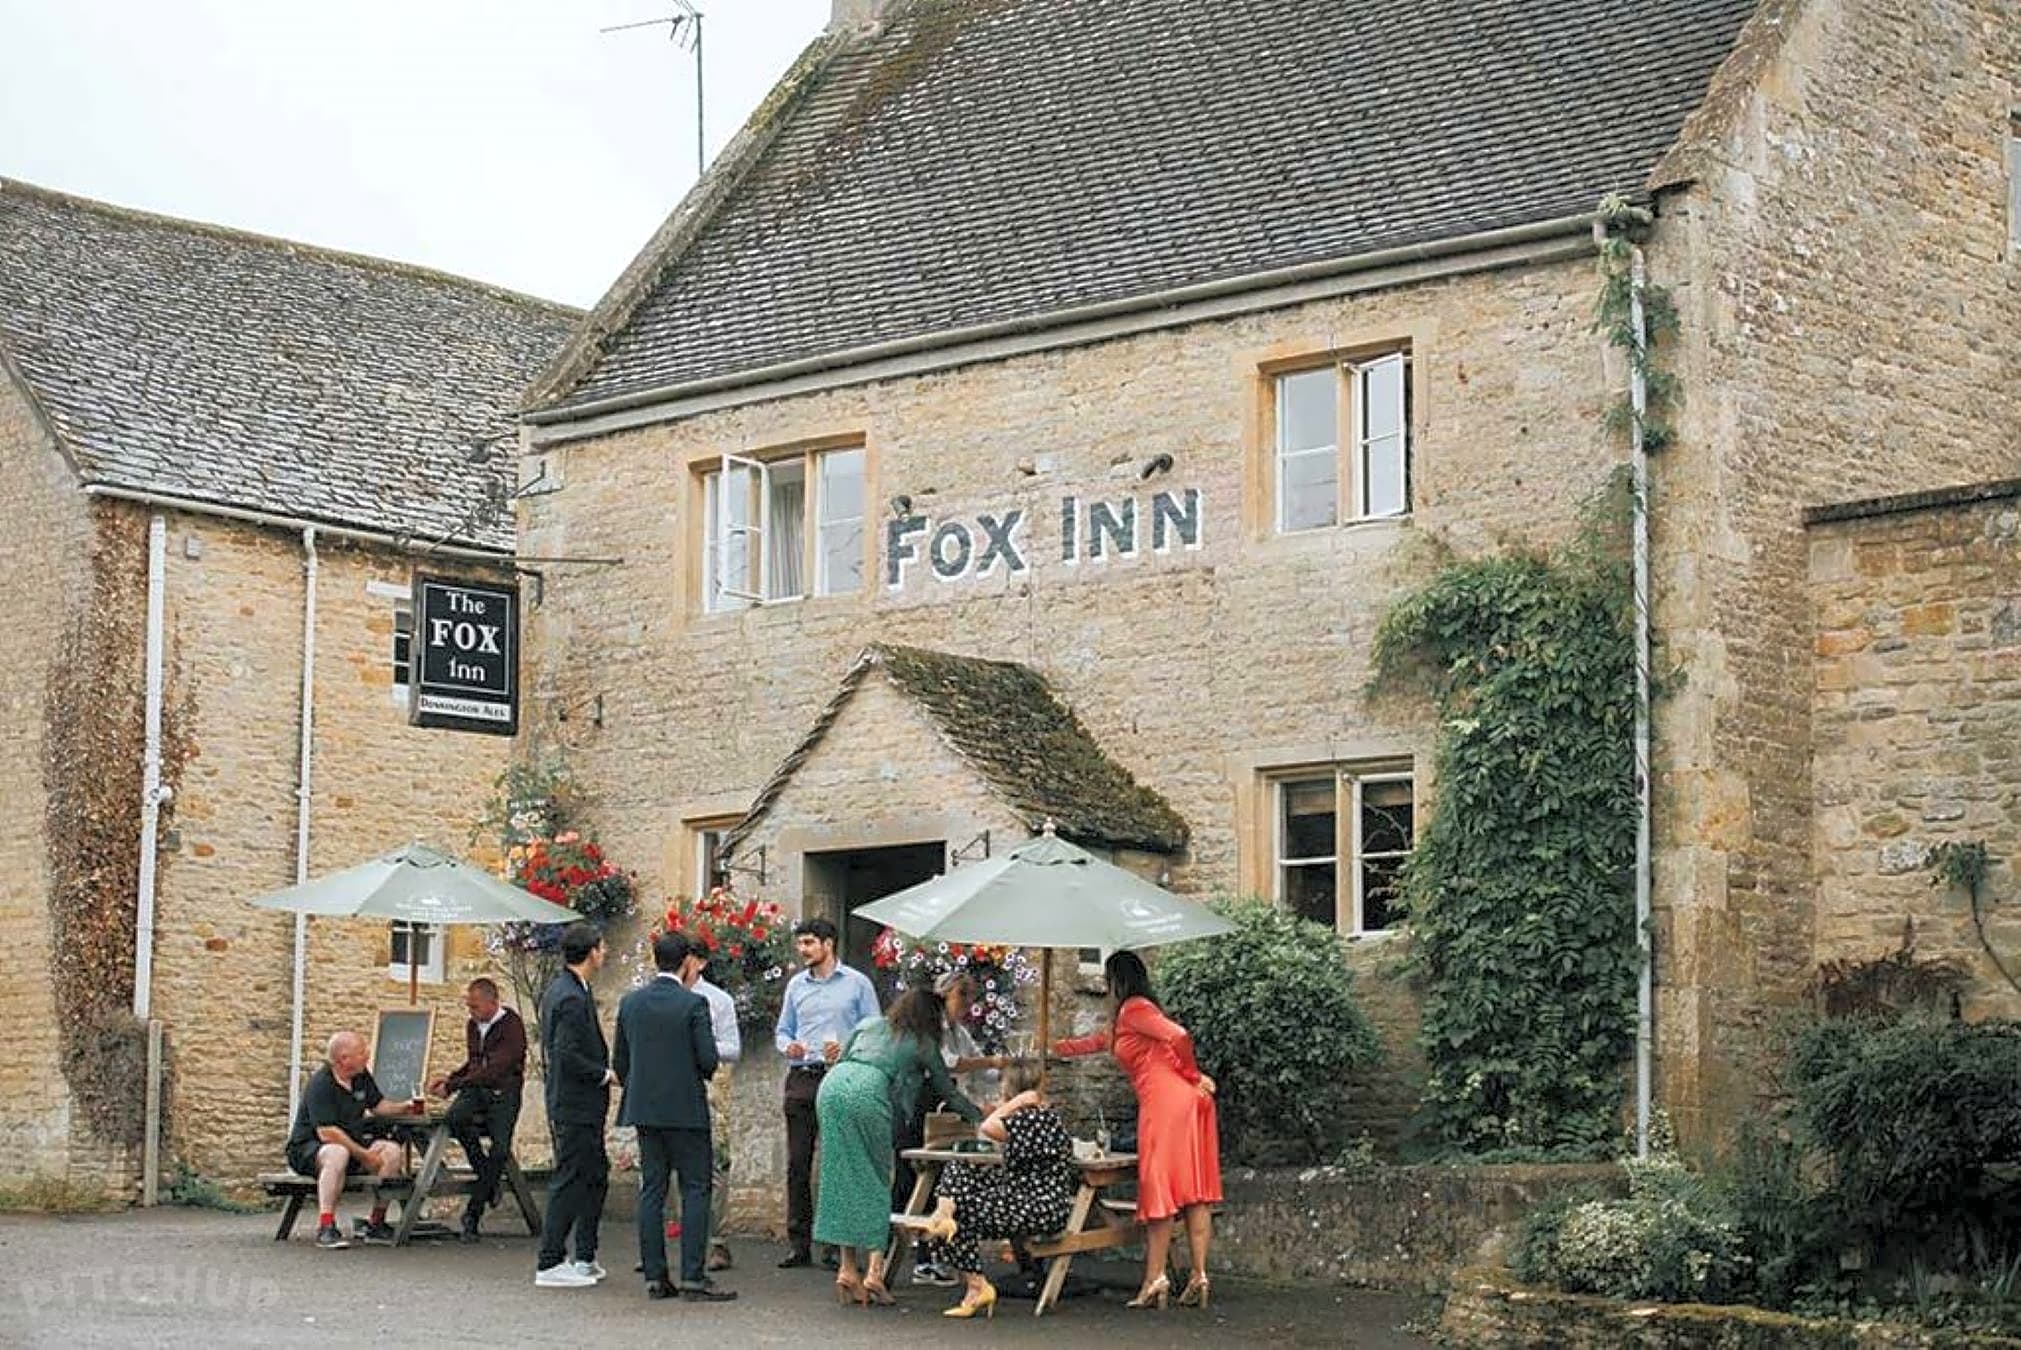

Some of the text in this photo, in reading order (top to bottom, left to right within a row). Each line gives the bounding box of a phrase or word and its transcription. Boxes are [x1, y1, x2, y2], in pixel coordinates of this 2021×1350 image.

[887, 488, 1202, 591] FOX INN
[447, 592, 486, 614] The
[431, 619, 500, 654] FOX
[449, 657, 485, 681] Inn
